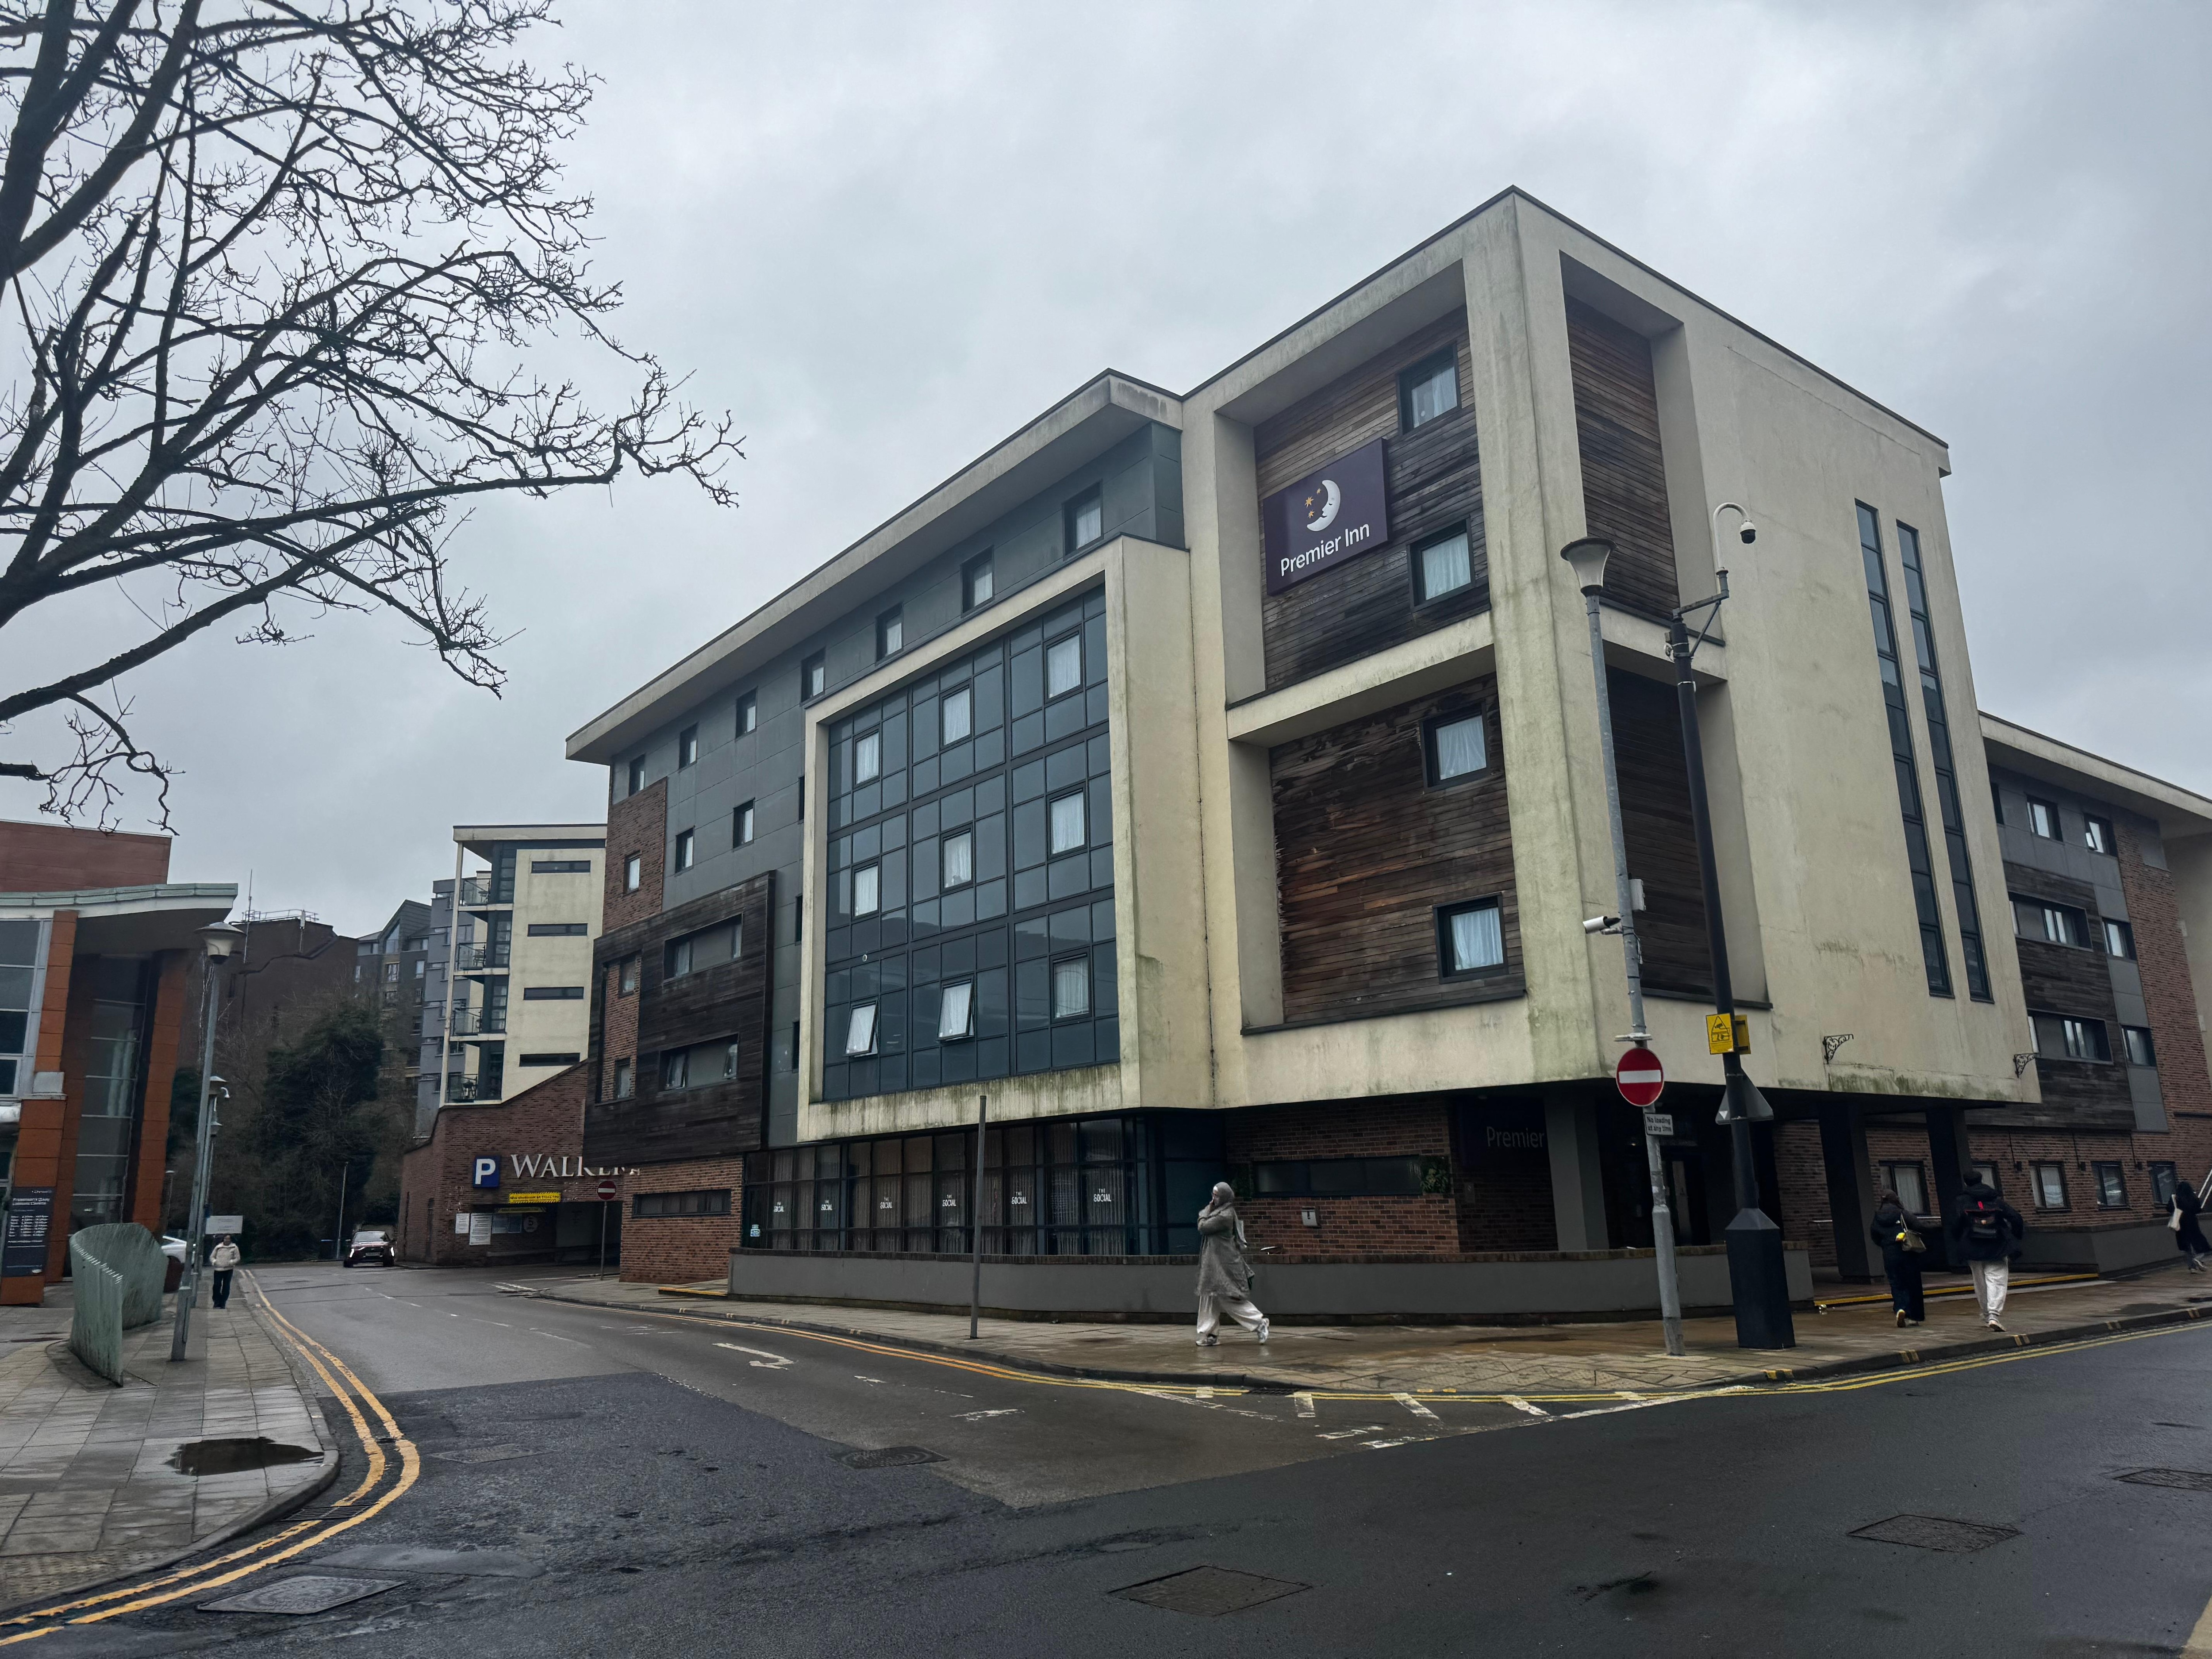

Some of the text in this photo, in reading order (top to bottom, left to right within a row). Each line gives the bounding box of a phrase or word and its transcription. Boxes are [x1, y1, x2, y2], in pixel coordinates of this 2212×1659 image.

[1280, 523, 1370, 576] Premier Inn
[1486, 1126, 1544, 1148] Premier
[475, 1158, 496, 1184] P
[1094, 1194, 1112, 1202] SOCIAL
